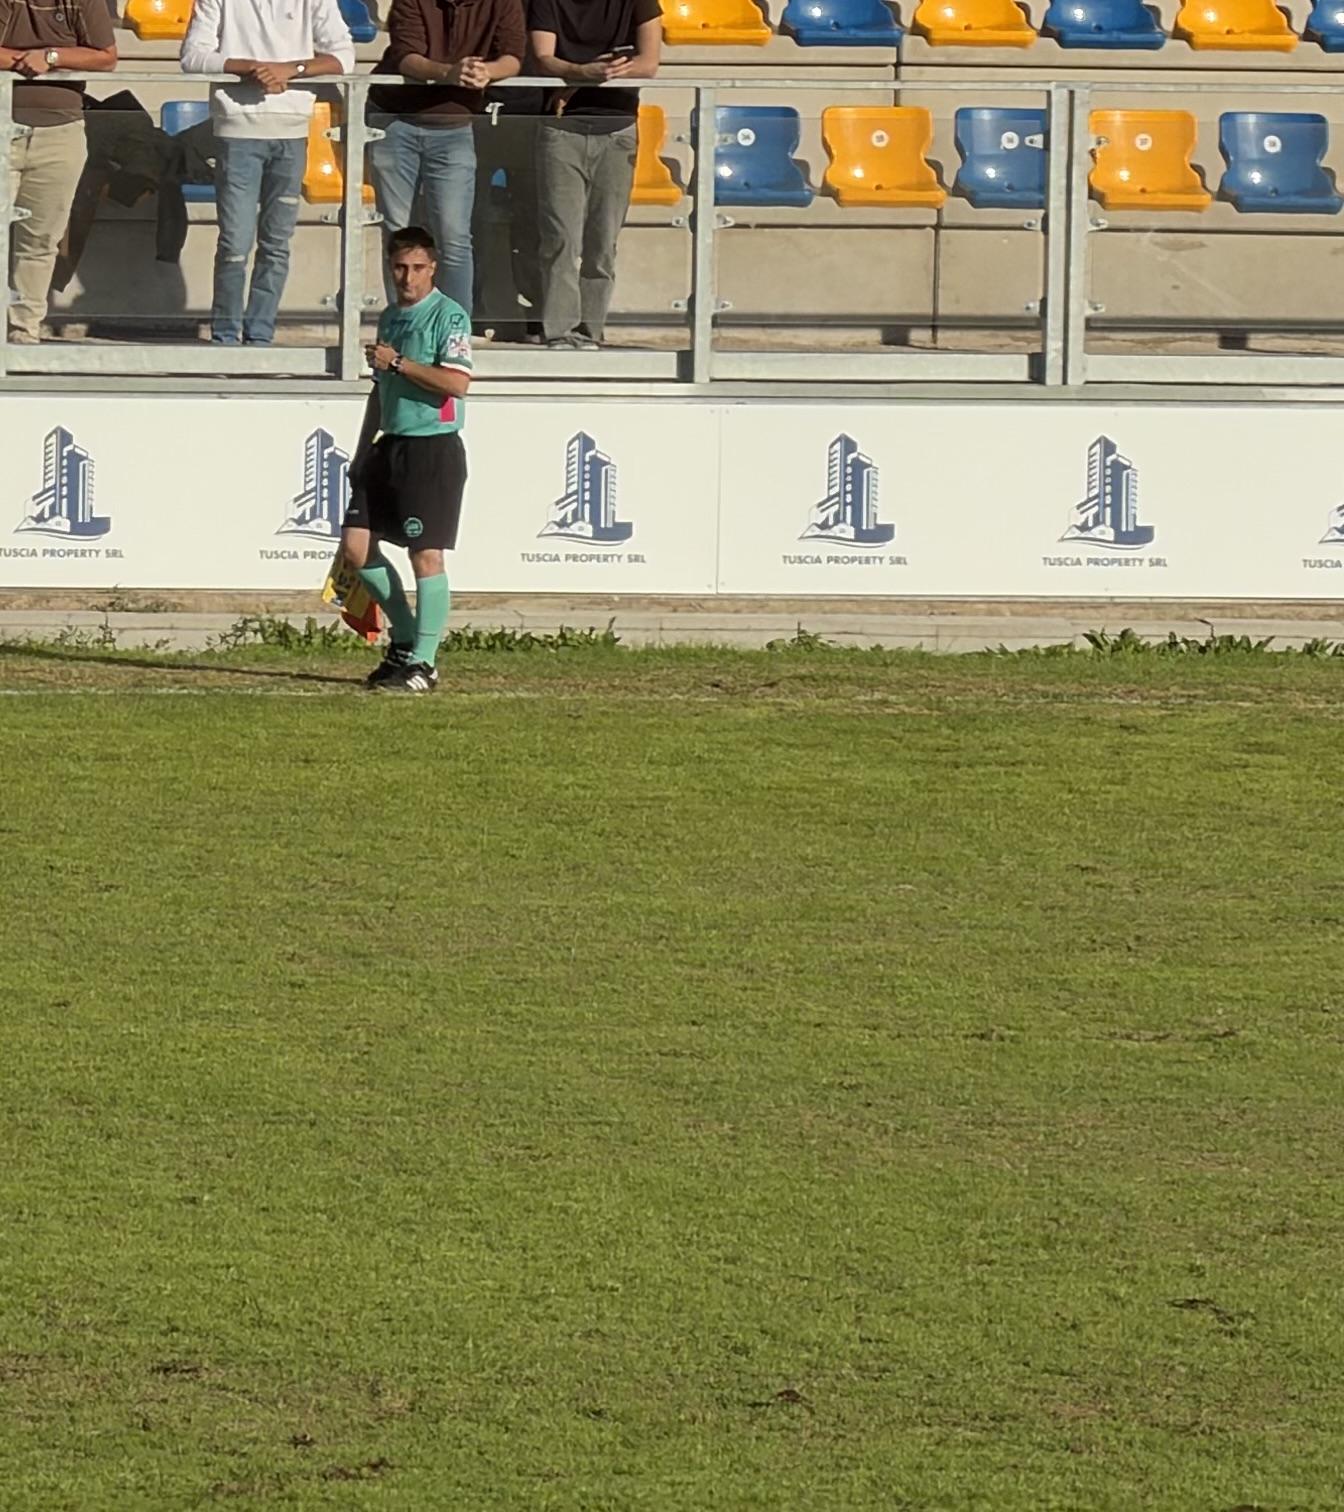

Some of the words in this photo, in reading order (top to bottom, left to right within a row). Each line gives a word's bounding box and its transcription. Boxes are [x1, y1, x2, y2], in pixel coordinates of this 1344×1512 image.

[42, 548, 101, 559] PROPERTY
[105, 548, 124, 559] SRL
[259, 549, 299, 560] TUSCIA
[520, 552, 561, 563] TUSCIA
[564, 553, 623, 563] PROPERTY
[627, 554, 646, 564] SRL
[782, 555, 823, 565] TUSCIA
[826, 555, 885, 565] PROPERTY
[889, 555, 908, 566] SRL
[1042, 556, 1083, 567] TUSCIA
[1086, 557, 1145, 567] PROPERTY
[1148, 557, 1168, 568] SRL
[1302, 558, 1343, 569] TUSCIA
